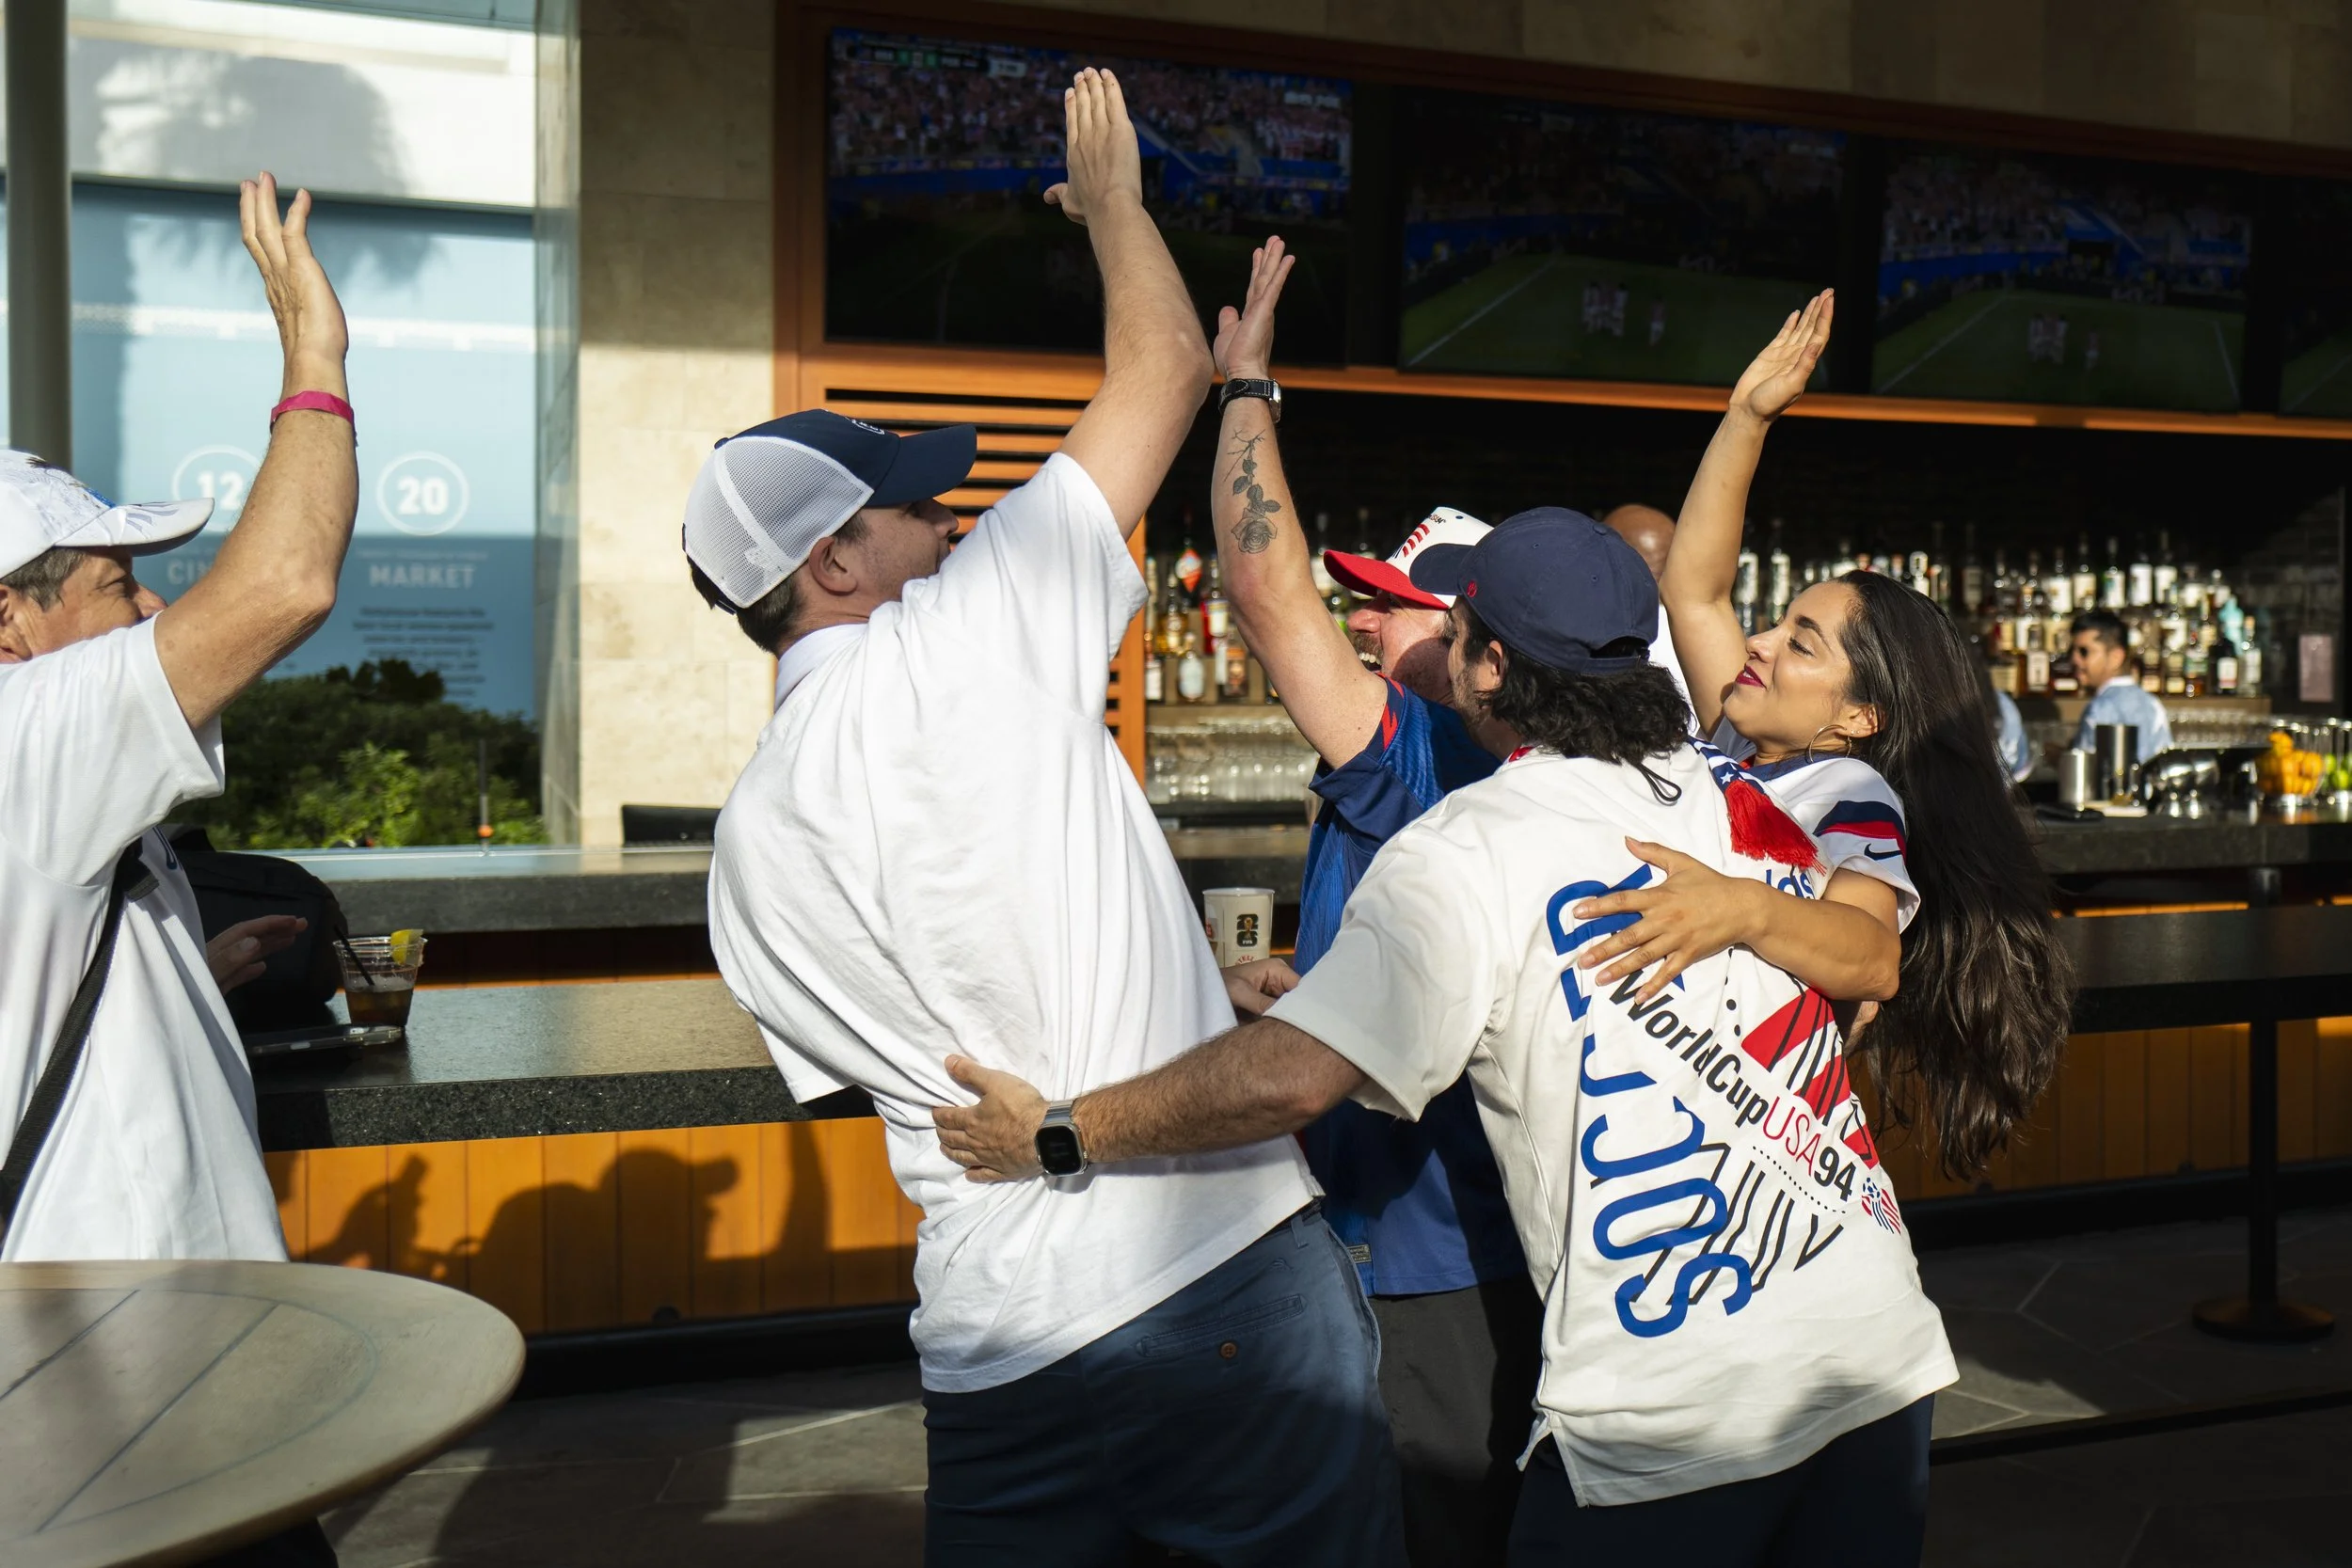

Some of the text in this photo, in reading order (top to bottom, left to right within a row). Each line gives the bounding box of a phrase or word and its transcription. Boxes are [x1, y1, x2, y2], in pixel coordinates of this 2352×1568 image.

[198, 470, 243, 511] 12
[397, 476, 450, 515] 20
[370, 563, 475, 590] MARKET
